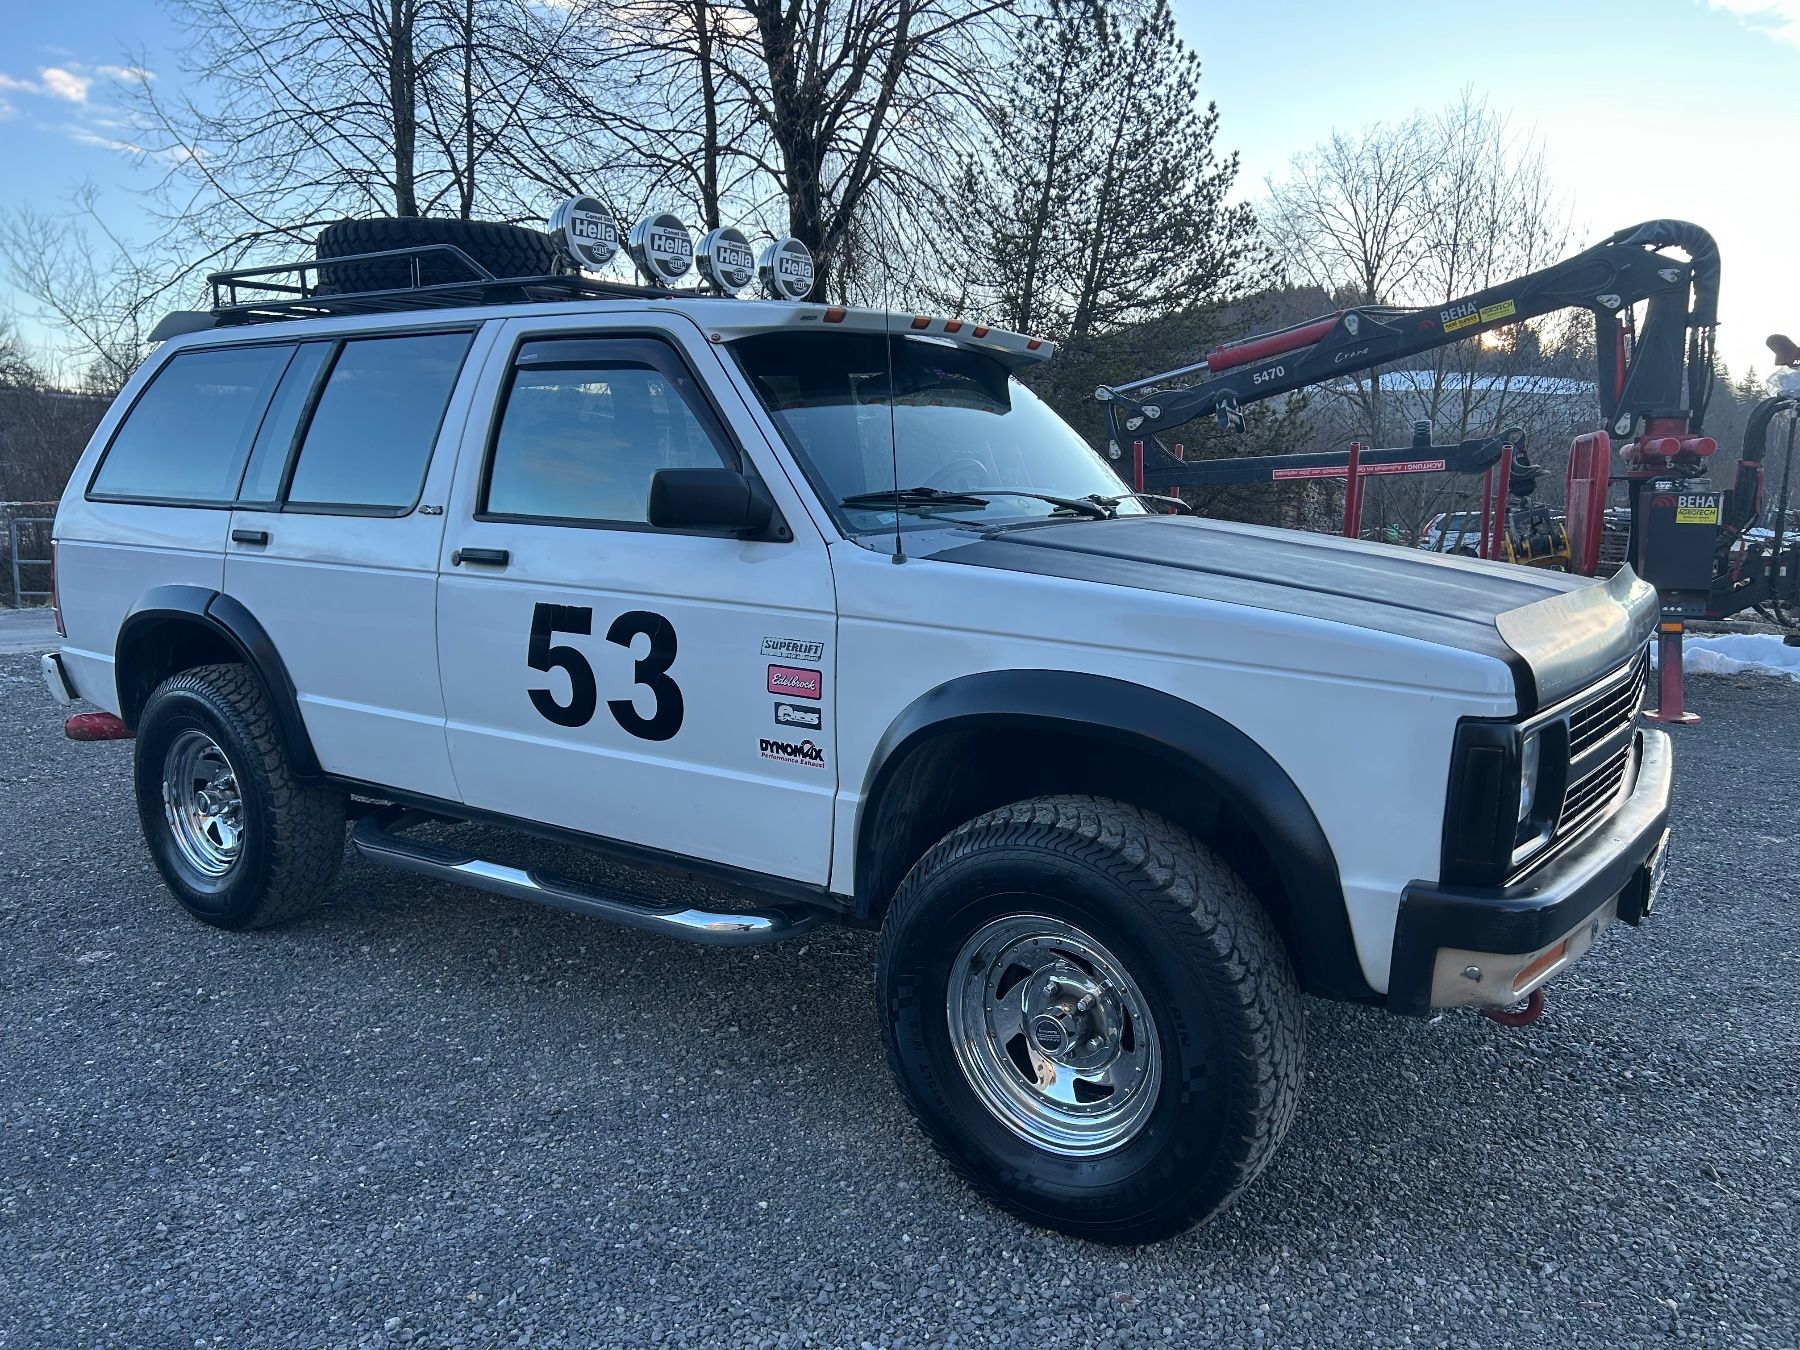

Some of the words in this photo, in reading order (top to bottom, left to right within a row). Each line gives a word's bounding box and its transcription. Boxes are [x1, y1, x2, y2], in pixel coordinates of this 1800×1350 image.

[585, 212, 603, 221] Comet
[575, 219, 615, 241] Hella
[663, 228, 680, 237] Comet
[653, 234, 690, 255] Hella
[719, 247, 752, 267] Hella
[781, 258, 812, 277] Hella
[1440, 302, 1477, 323] BEHA
[1335, 347, 1369, 363] Crane
[1253, 365, 1285, 385] 5470
[1678, 495, 1715, 507] BEHA
[764, 639, 821, 655] SUPERLIFT
[527, 602, 684, 741] 53
[771, 672, 816, 690] Edelbrock
[760, 739, 824, 762] DYNOMAX
[761, 751, 799, 764] Performance
[800, 758, 825, 769] Exhaust
